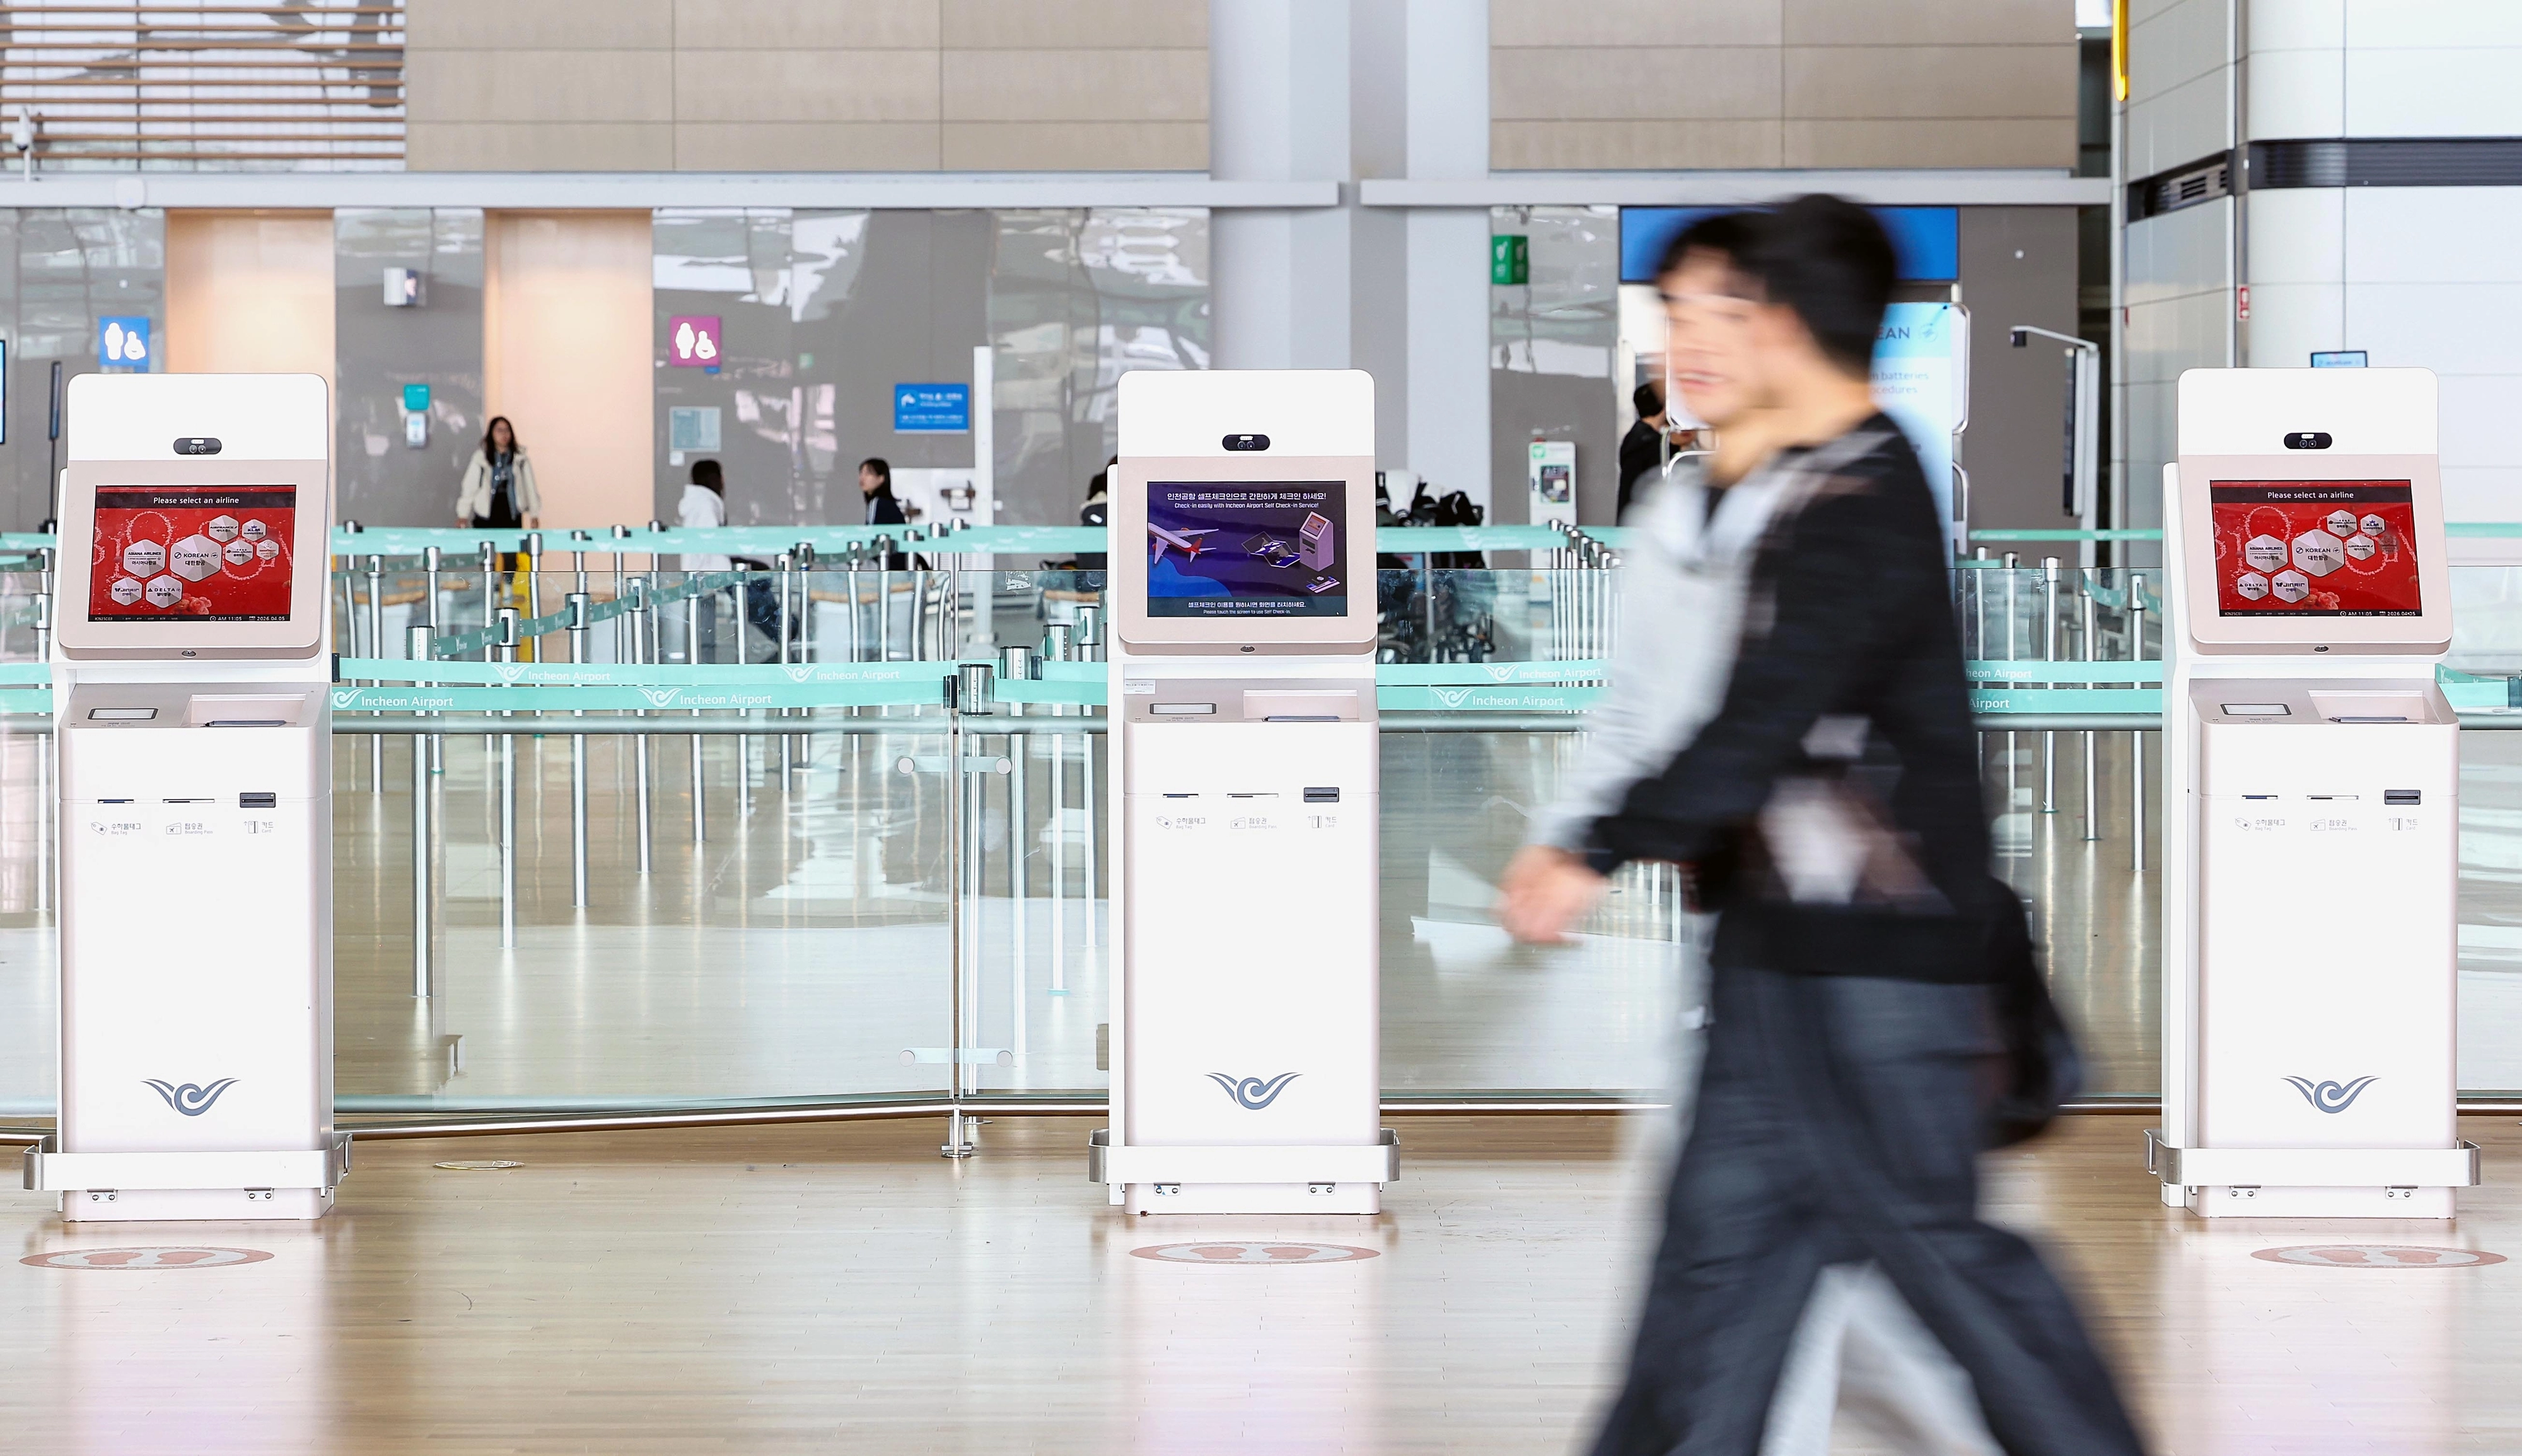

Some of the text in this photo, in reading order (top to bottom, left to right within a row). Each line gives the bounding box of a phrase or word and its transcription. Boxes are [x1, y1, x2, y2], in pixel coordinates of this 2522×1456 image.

[528, 671, 611, 682] Incheon Airport
[816, 669, 900, 681] Incheon Airport
[1520, 668, 1602, 679] Incheon Airport
[1965, 668, 2032, 679] heon Airport
[361, 695, 453, 708] Incheon Airport
[680, 693, 772, 706] Incheon Airport
[1472, 695, 1564, 708] Incheon Airport
[1968, 698, 2010, 710] Airport
